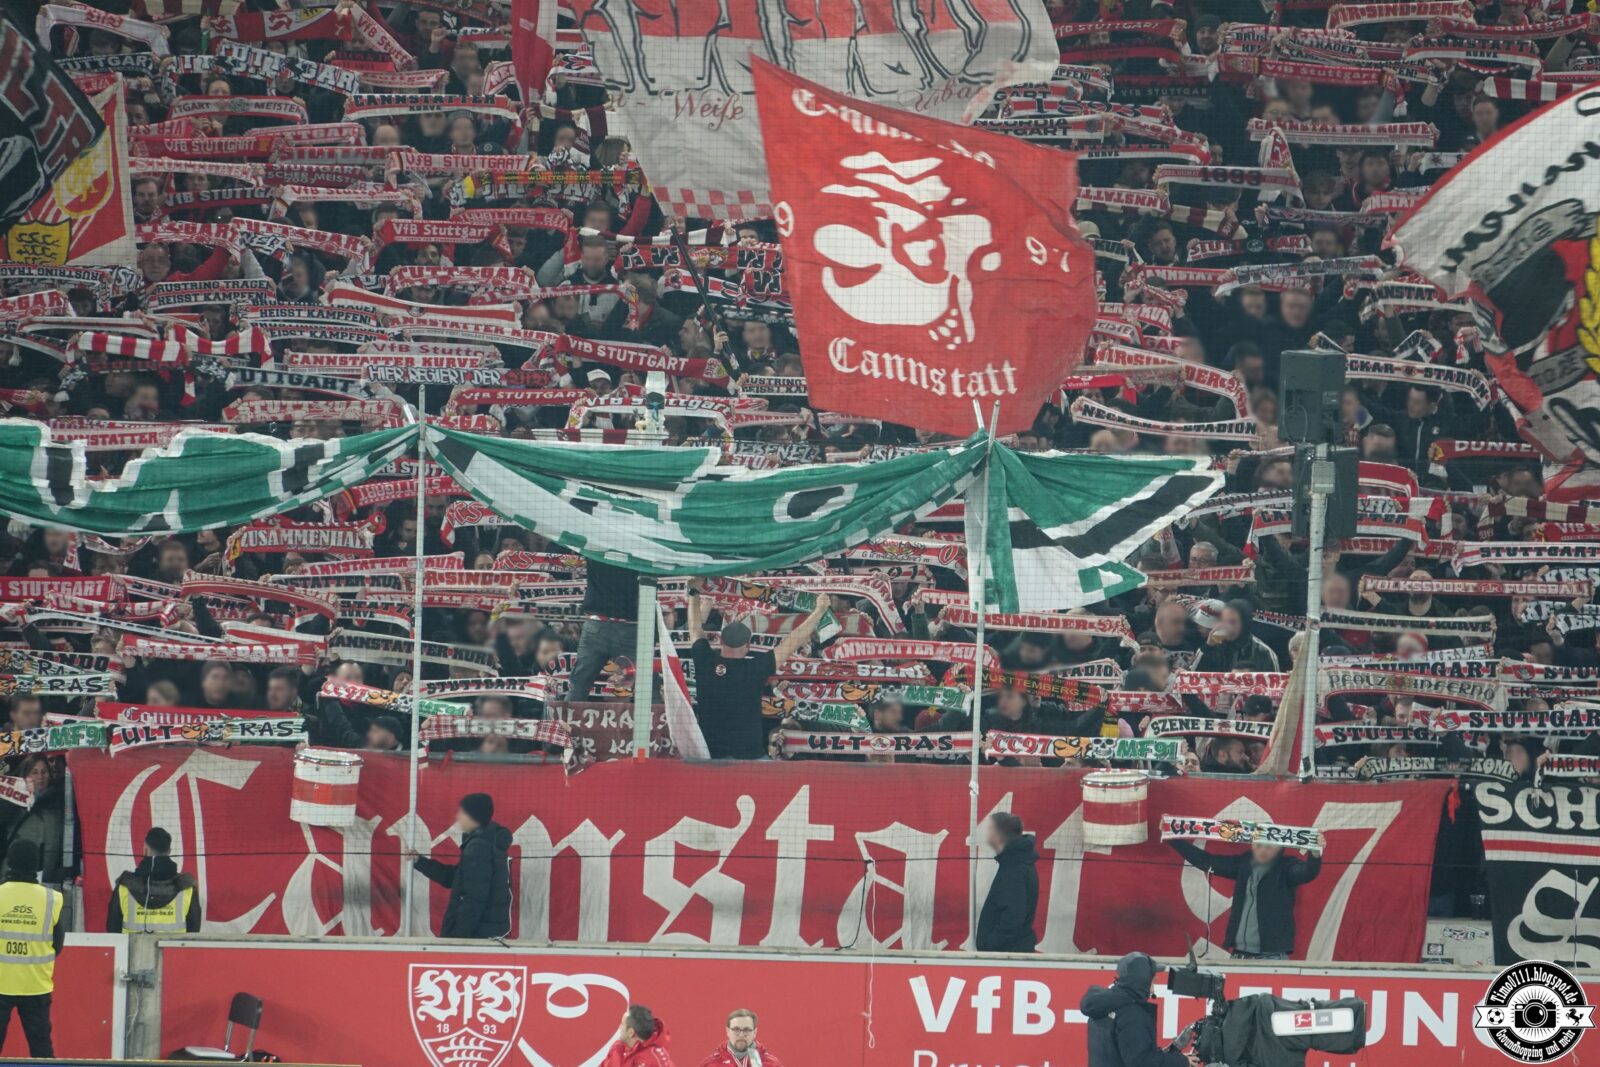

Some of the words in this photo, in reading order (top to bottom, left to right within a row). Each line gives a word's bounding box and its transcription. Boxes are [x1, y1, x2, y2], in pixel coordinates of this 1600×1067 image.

[354, 95, 497, 107] CANNSTATTER
[1376, 123, 1430, 136] KURVE
[443, 154, 525, 170] STUTTGART
[200, 187, 274, 202] STUTTGA
[393, 223, 418, 236] VfB
[422, 222, 490, 239] Stuttgart
[157, 293, 200, 306] HEISST
[259, 309, 302, 319] HEISST
[289, 354, 415, 367] CANNSTATTER
[421, 355, 479, 367] KURVE
[570, 338, 593, 354] VfB
[597, 345, 688, 371] STUTTGART
[368, 366, 404, 385] HIER
[829, 337, 1018, 399] Cannstatt
[496, 390, 587, 400] STUTTGART
[8, 580, 104, 598] STUTTGART
[518, 585, 587, 600] NECKA
[1365, 578, 1478, 593] VOLKSSPORT
[48, 676, 104, 693] RAS
[239, 719, 295, 737] RAS
[807, 734, 866, 751] ULT
[893, 734, 955, 751] RAS
[992, 734, 1053, 755] CC97
[1170, 819, 1215, 835] ULT
[1266, 826, 1311, 846] RAS
[13, 904, 33, 913] SDS
[6, 941, 28, 956] 0303
[413, 968, 522, 1025] VfB
[435, 1022, 451, 1034] 18
[482, 1023, 498, 1035] 93
